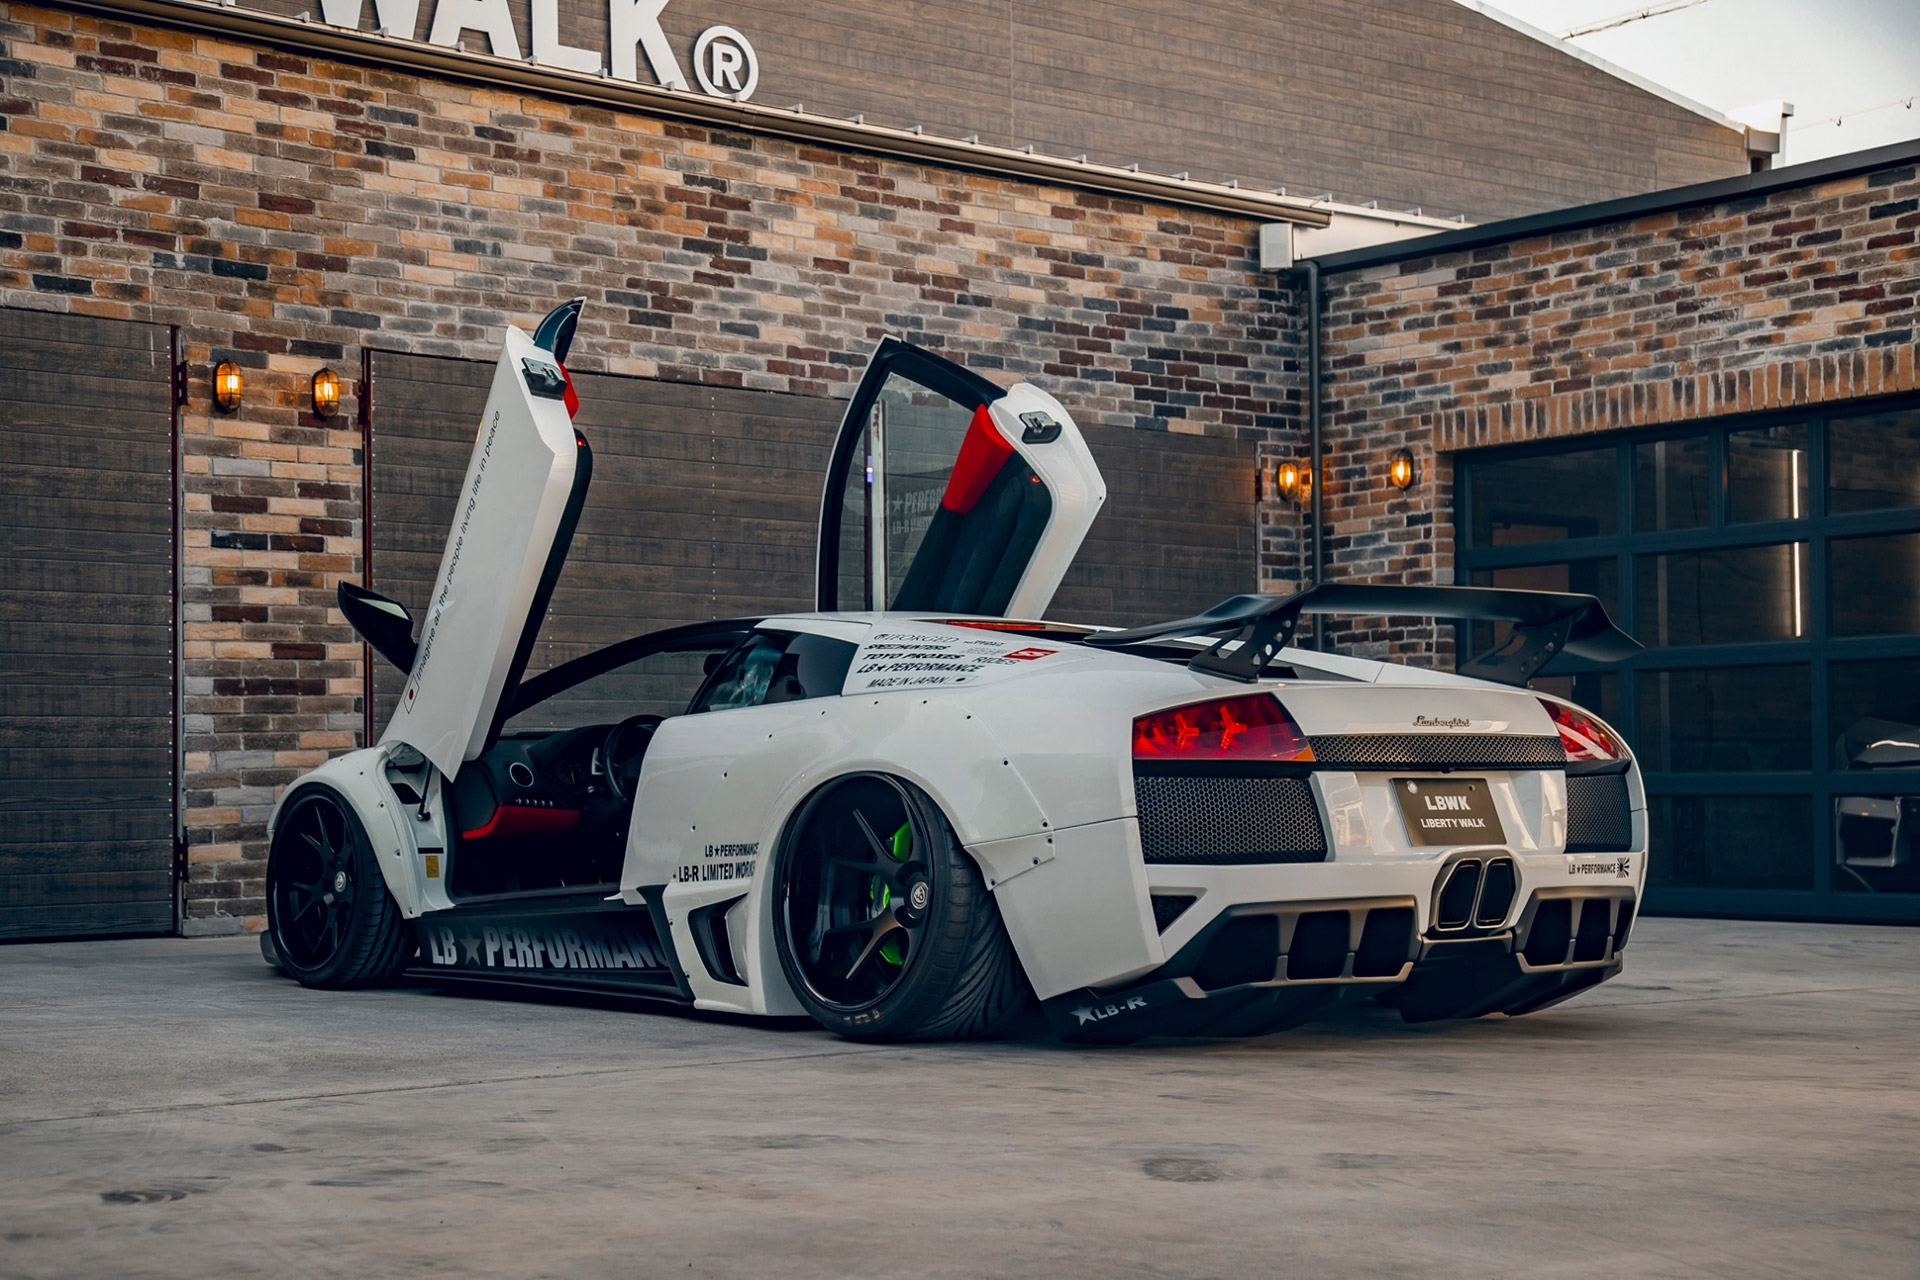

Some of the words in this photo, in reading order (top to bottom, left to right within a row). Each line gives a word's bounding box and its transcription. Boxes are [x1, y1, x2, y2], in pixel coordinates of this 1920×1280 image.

[320, 0, 690, 92] ALK
[904, 486, 946, 514] PERFOR
[415, 627, 436, 682] Imagine
[433, 609, 441, 625] all
[438, 584, 448, 608] the
[447, 537, 463, 585] people
[460, 497, 476, 535] living
[471, 473, 482, 497] life
[479, 457, 487, 472] in
[484, 410, 500, 457] peace
[856, 663, 879, 674] LB
[884, 662, 985, 673] PERFORMANCE
[866, 677, 901, 689] MADE
[896, 677, 913, 687] IN
[909, 676, 950, 686] JAPAN
[1412, 714, 1472, 730] Lamborghini
[1424, 795, 1472, 811] LBWK
[1420, 818, 1458, 828] LIBERTY
[1457, 818, 1486, 828] WALK
[704, 844, 714, 858] LB
[720, 842, 759, 857] PERFORMANCE
[678, 865, 700, 883] LB-R
[702, 862, 734, 881] LIMITED
[735, 860, 757, 880] WORKS
[1568, 864, 1576, 875] LB
[1581, 863, 1616, 875] PERFORMANCE
[428, 926, 458, 965] LB
[482, 924, 671, 969] PERFORMAN
[1094, 995, 1148, 1020] LB-R
